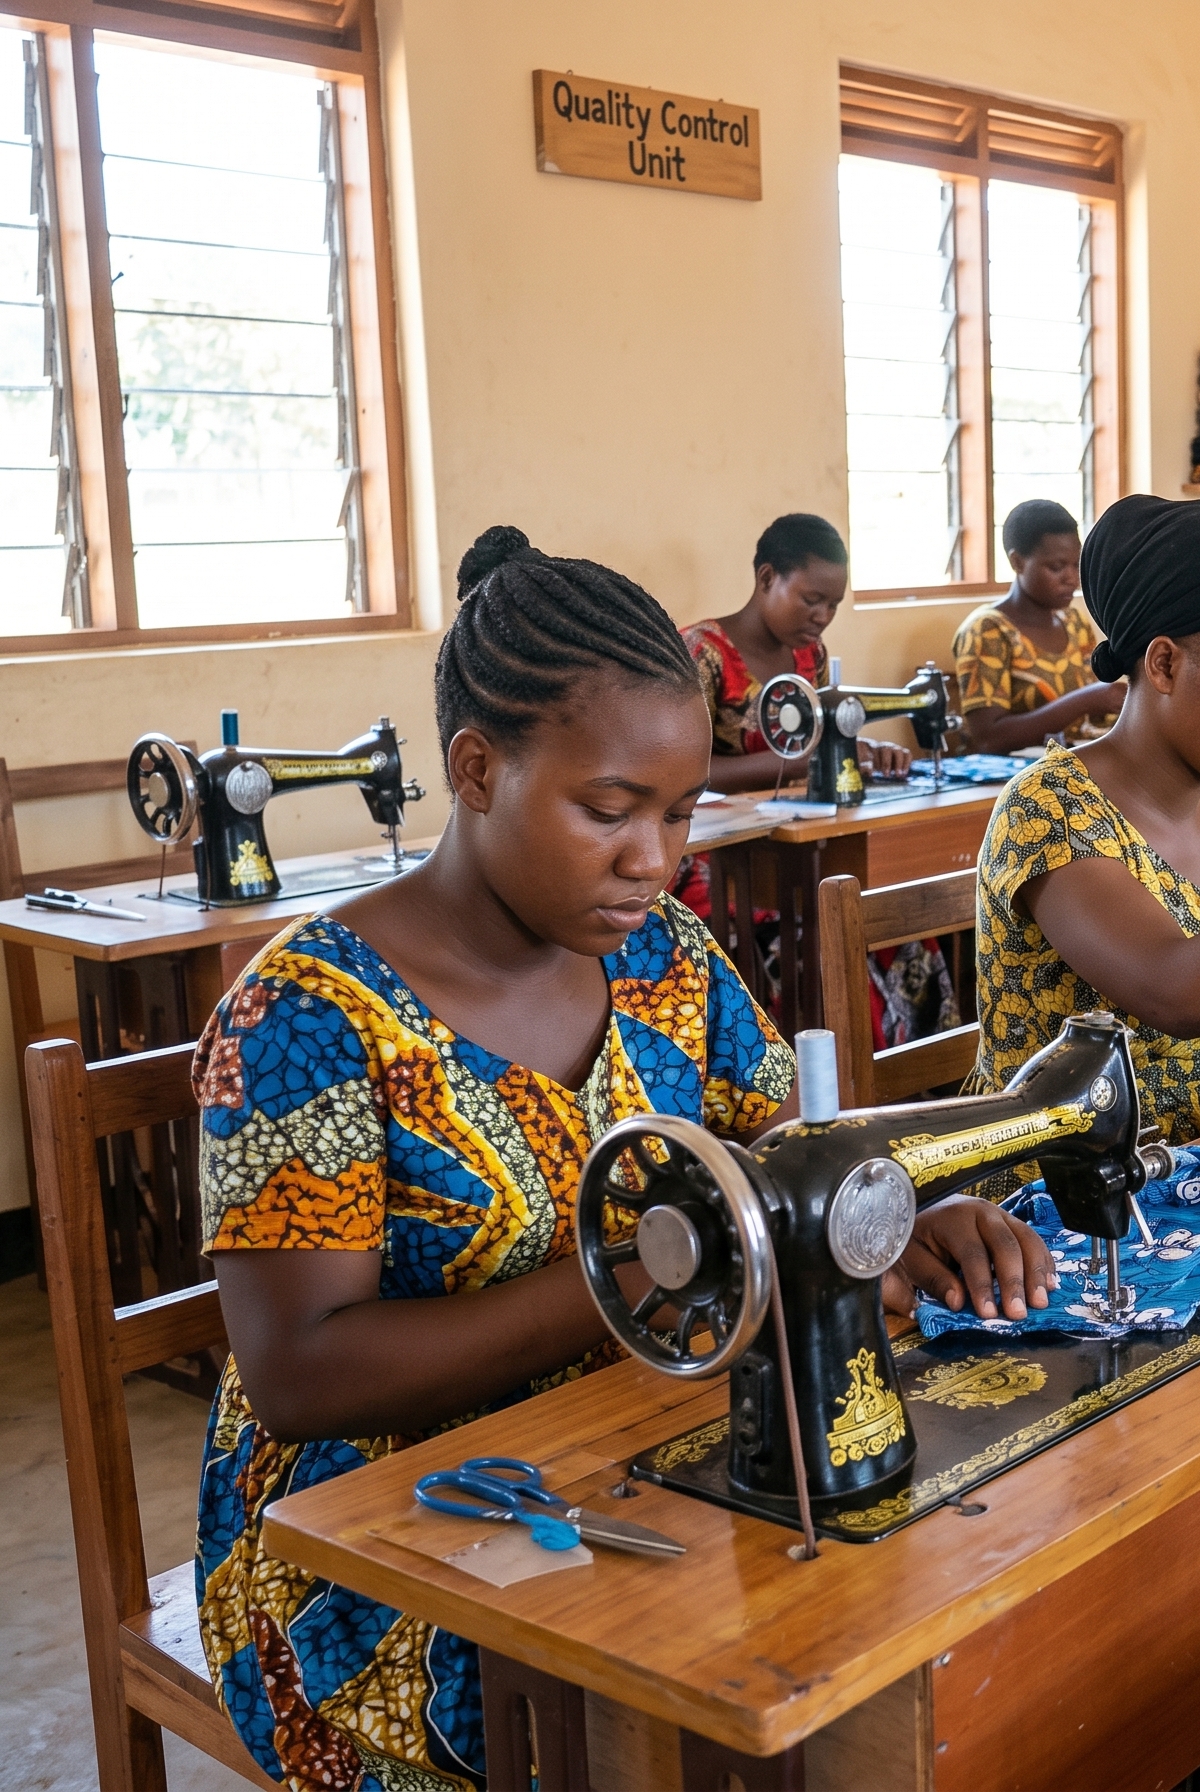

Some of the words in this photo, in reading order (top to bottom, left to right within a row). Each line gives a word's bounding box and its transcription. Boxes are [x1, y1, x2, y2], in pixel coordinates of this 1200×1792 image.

[553, 80, 651, 142] Quality
[661, 100, 749, 148] Control
[628, 140, 686, 182] Unit
